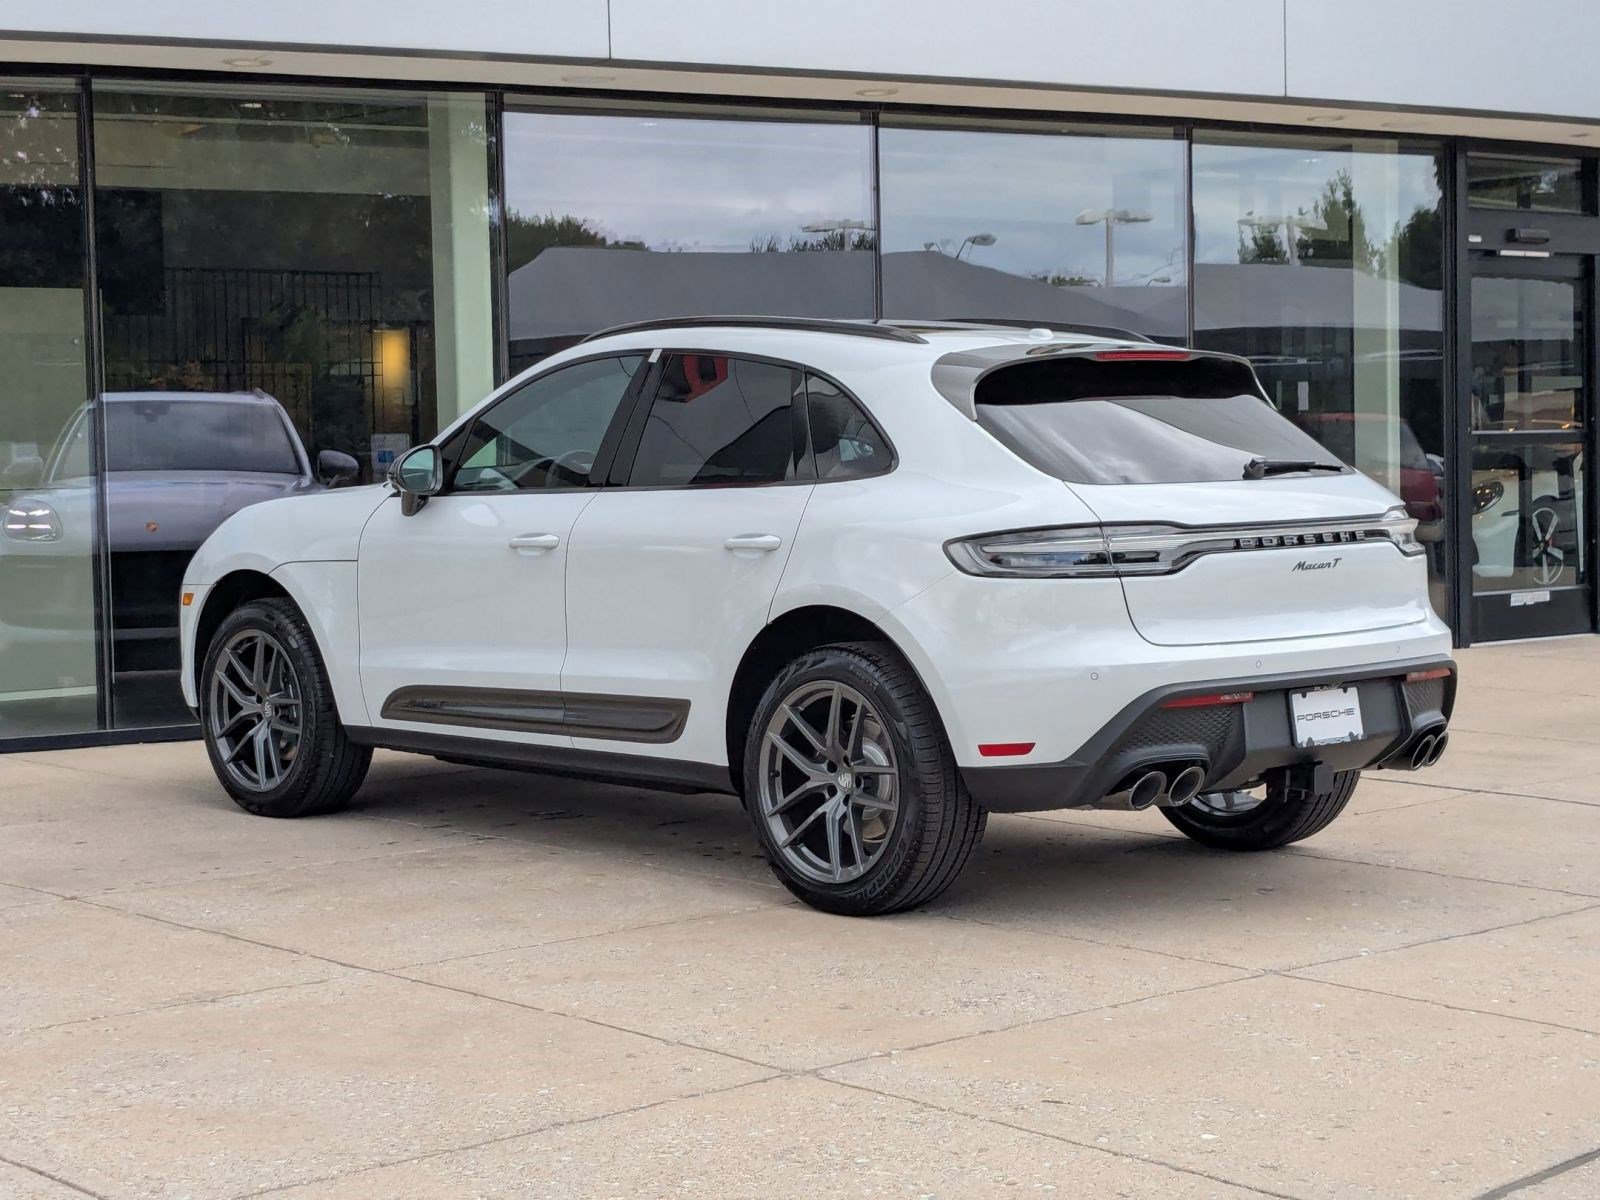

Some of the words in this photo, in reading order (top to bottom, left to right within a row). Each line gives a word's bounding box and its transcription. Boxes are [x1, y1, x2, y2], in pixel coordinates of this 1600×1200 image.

[1239, 530, 1366, 549] PORSCHE
[1292, 560, 1331, 572] Macan
[1332, 557, 1343, 568] T
[1296, 707, 1356, 722] PORSCHE
